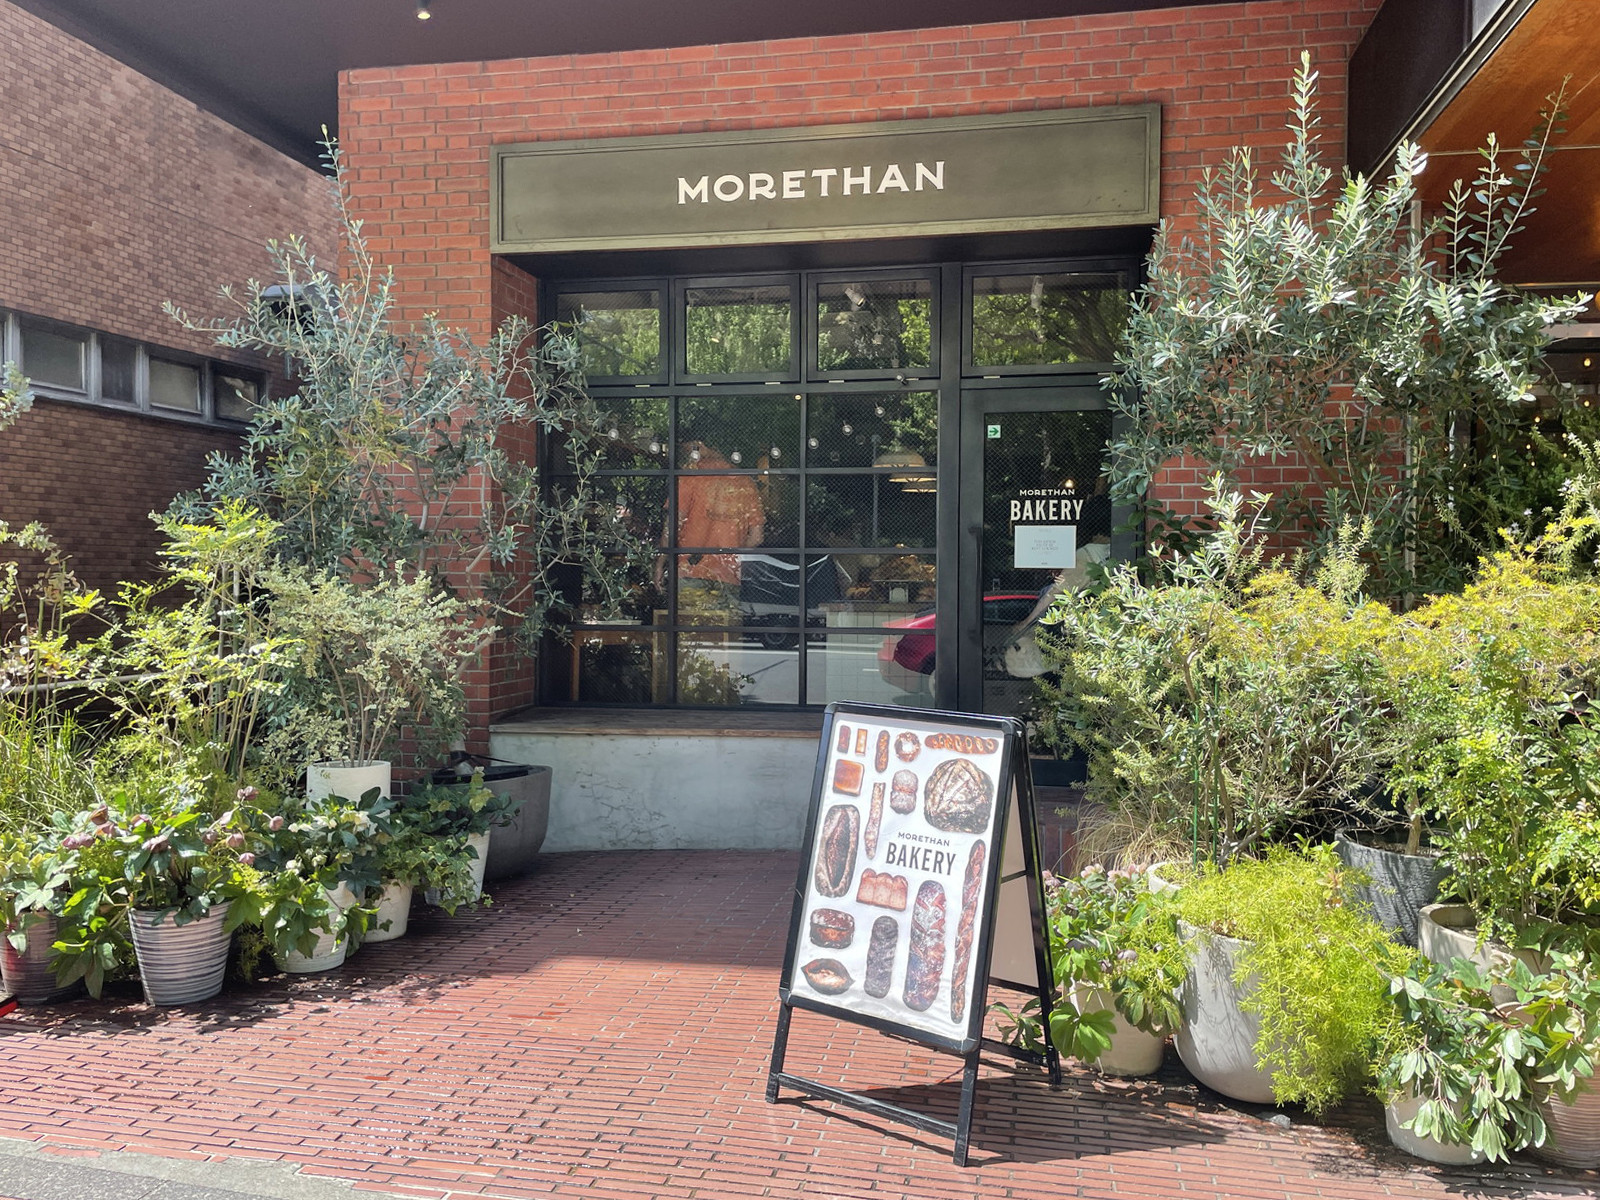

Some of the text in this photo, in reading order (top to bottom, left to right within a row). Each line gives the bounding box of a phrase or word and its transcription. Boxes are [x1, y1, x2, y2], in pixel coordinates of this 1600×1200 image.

[677, 161, 945, 205] MORETHAN
[1019, 488, 1076, 496] MORETHAN
[1010, 499, 1084, 521] BAKERY
[897, 831, 950, 847] MORETHAN
[885, 841, 957, 876] BAKERY
